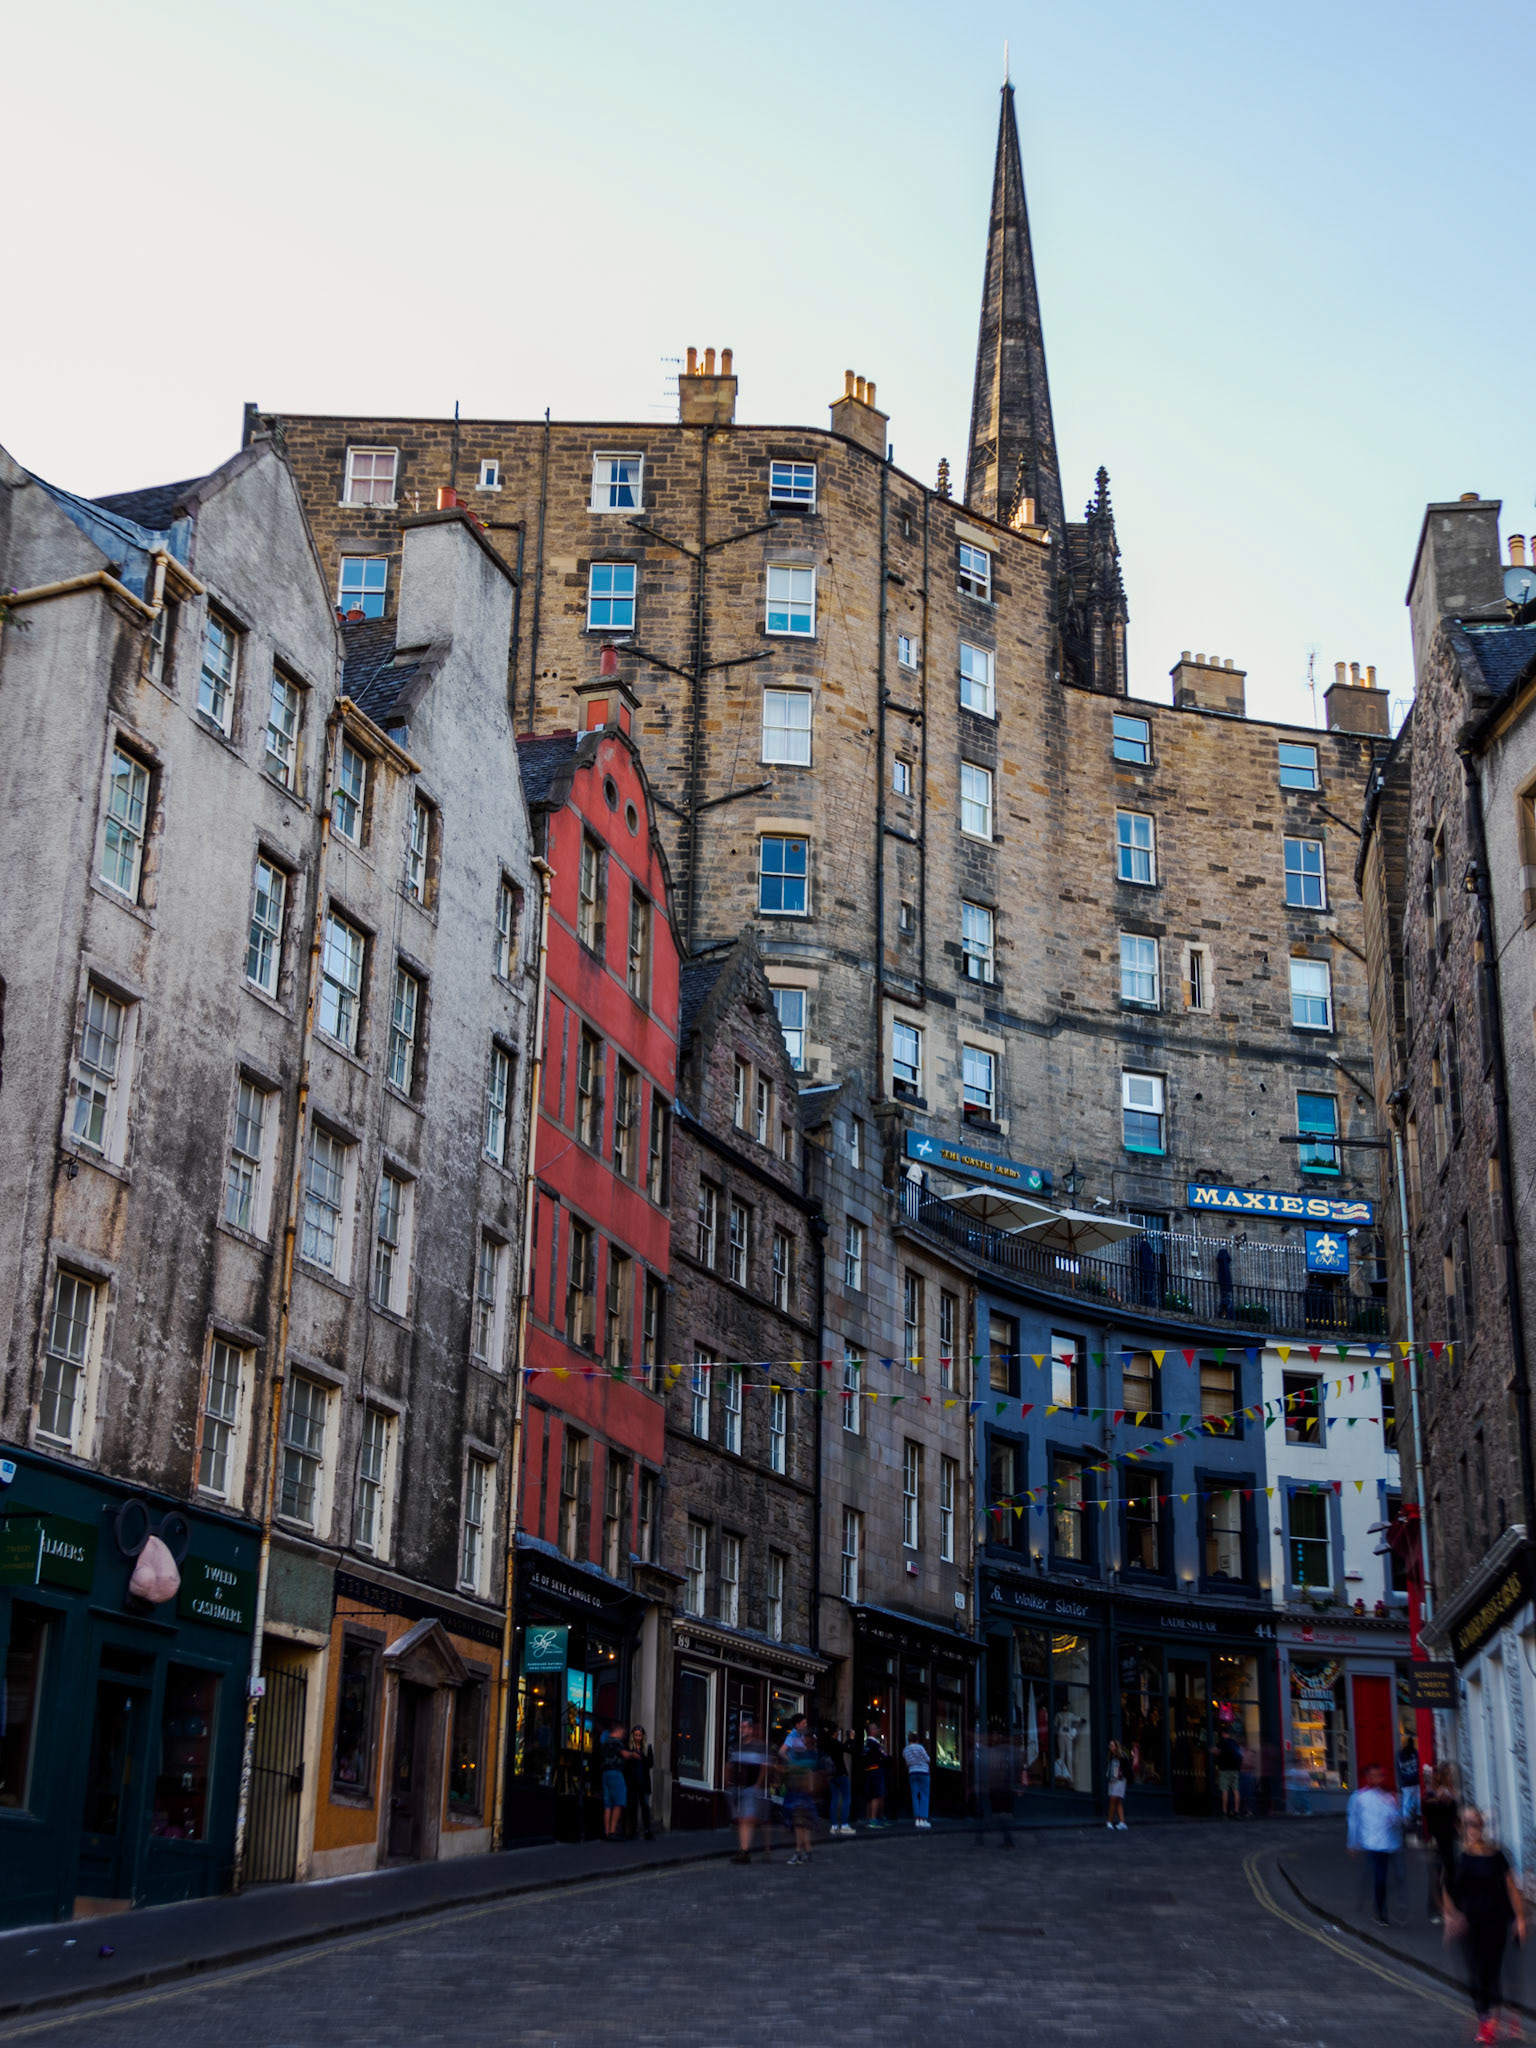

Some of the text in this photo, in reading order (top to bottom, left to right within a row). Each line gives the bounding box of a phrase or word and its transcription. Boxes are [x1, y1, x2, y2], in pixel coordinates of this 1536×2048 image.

[961, 1155, 992, 1171] CASTLE
[1193, 1187, 1330, 1217] MAXIES
[204, 1564, 238, 1586] TWEED
[214, 1586, 223, 1600] &
[541, 1575, 549, 1586] OF
[551, 1579, 567, 1594] SKYE
[568, 1586, 591, 1604] CANDLE
[192, 1598, 243, 1624] CASHMERE
[1015, 1592, 1088, 1616] Walker Slater
[1160, 1615, 1217, 1633] LADIESWEAR
[678, 1634, 690, 1649] 89
[804, 1672, 815, 1686] 89
[1413, 1671, 1451, 1679] SCOTTISH
